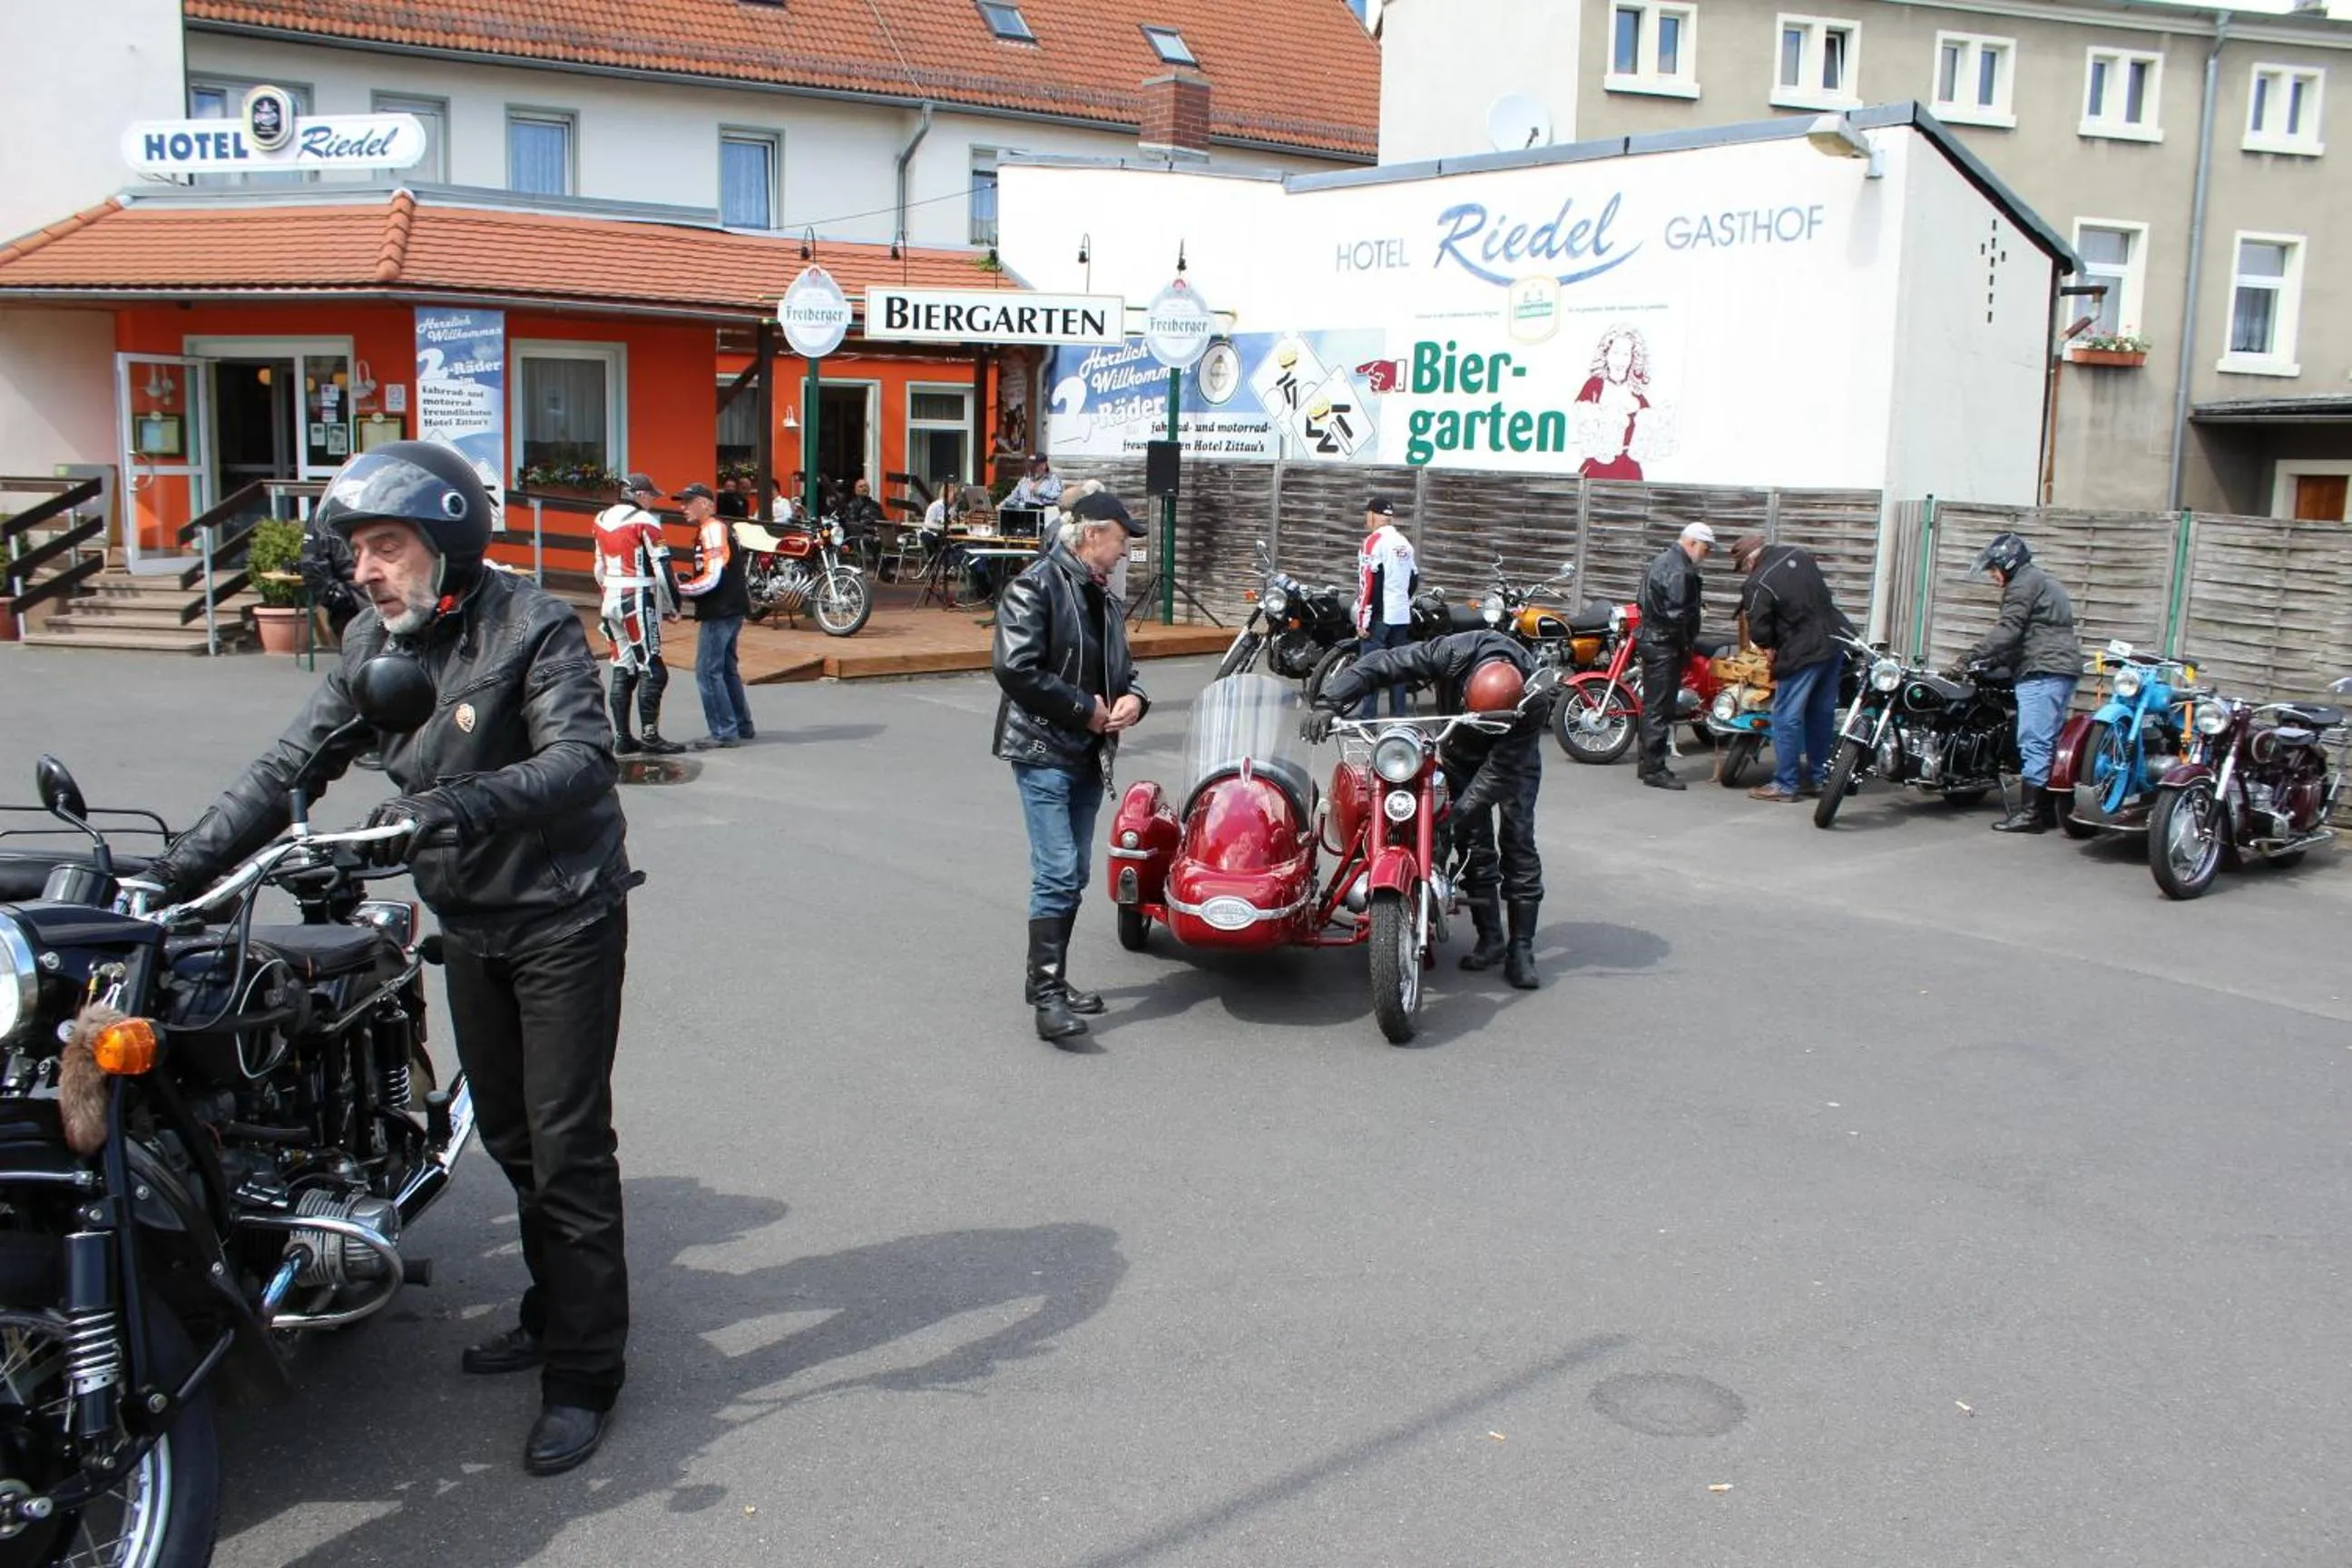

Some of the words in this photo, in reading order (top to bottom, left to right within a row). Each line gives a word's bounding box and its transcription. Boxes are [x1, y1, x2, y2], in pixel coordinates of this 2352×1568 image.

[144, 132, 248, 161] HOTEL
[297, 125, 399, 160] Riedel
[1335, 238, 1411, 272] HOTEL
[1433, 191, 1629, 274] Riedel
[1664, 204, 1824, 251] GASTHOF
[785, 304, 845, 324] Freiberger
[884, 295, 1106, 337] BIERGARTEN
[1149, 316, 1209, 336] Freiberger
[1078, 342, 1149, 378] Herzlich
[1411, 339, 1527, 395] Bier-
[1091, 363, 1191, 395] Willkommn
[424, 418, 453, 427] Hotel
[1195, 421, 1216, 433] und
[1217, 421, 1272, 433] motorrad-
[1405, 400, 1567, 466] garten
[1193, 439, 1222, 452] Hotel
[1224, 439, 1265, 453] Zittau's
